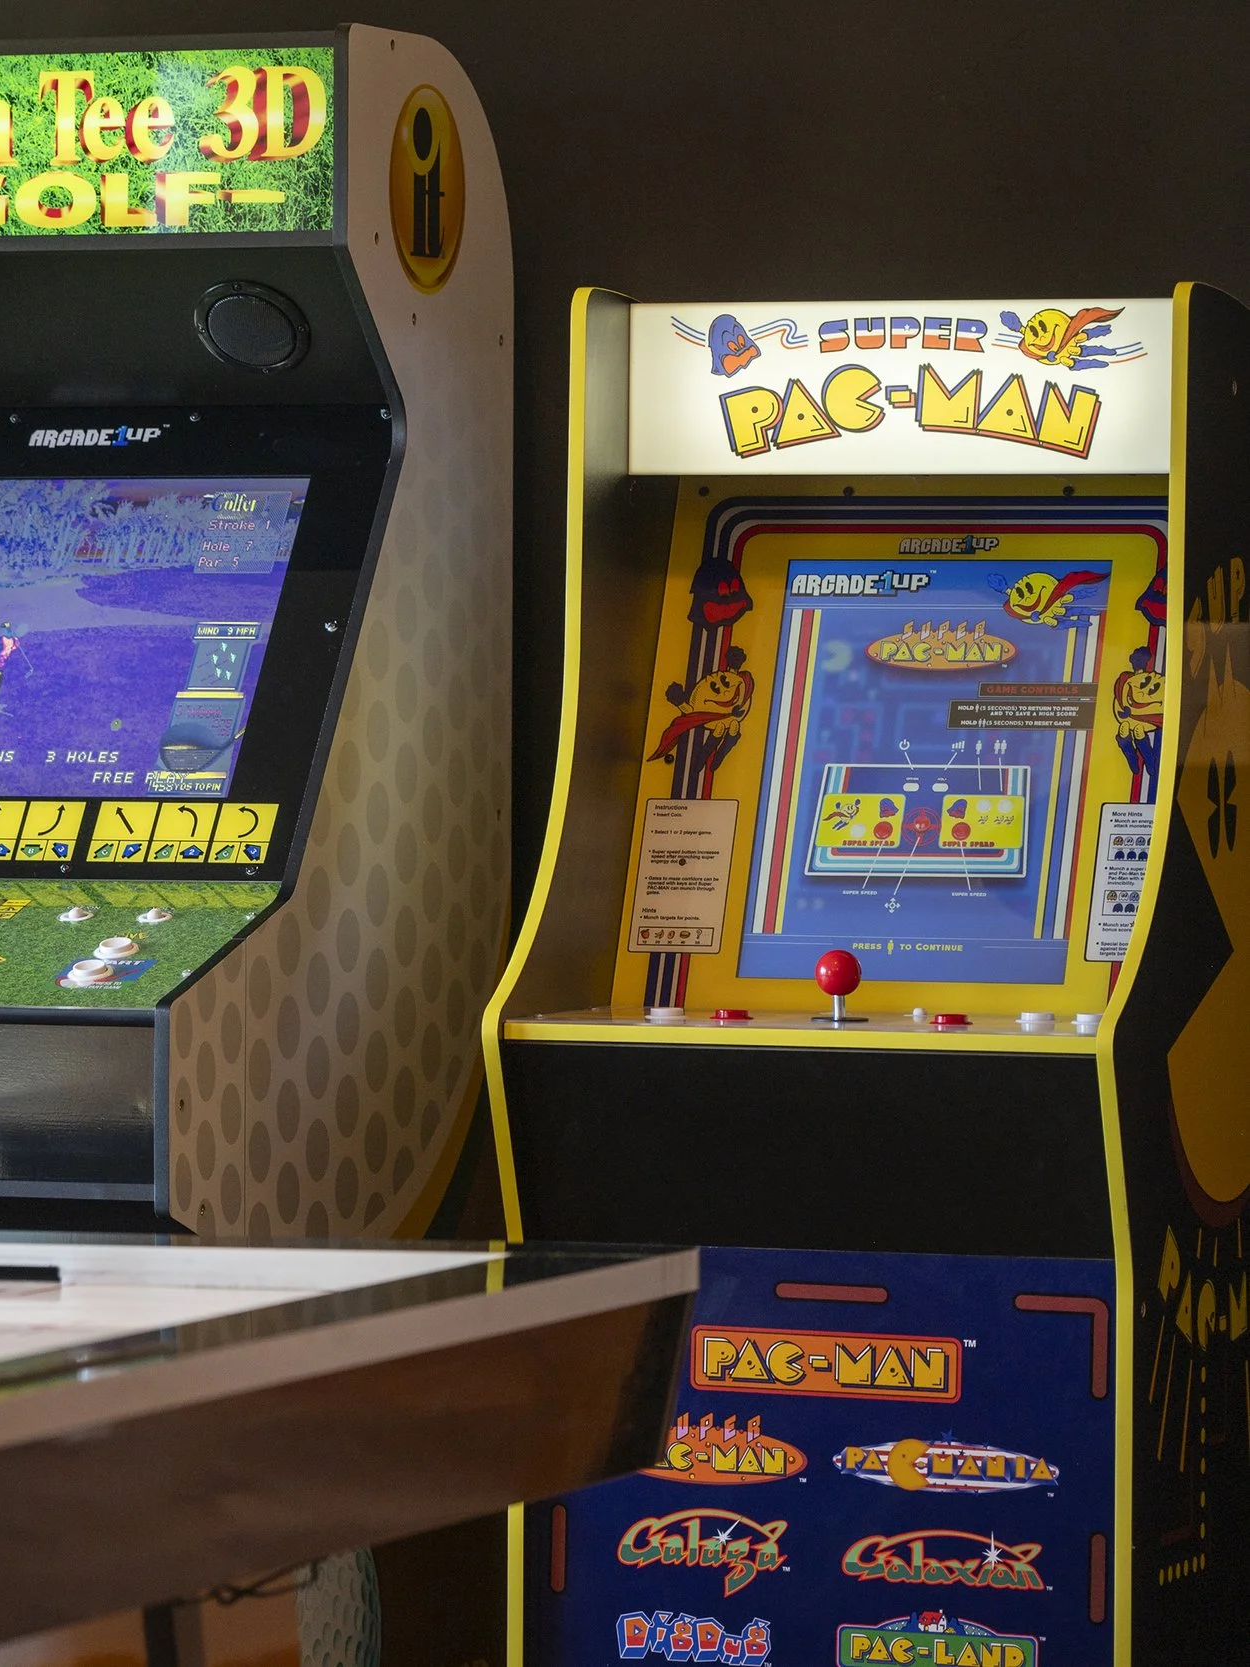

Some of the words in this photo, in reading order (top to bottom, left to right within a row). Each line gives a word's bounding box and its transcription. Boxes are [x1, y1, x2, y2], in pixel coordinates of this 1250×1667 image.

[38, 69, 177, 166] Tee
[199, 63, 327, 163] 3D
[818, 315, 986, 354] SUPER
[718, 363, 1102, 460] PAC-MAN
[28, 425, 161, 448] ARCADE1UP
[208, 520, 255, 530] Stroke
[265, 520, 271, 530] 1
[202, 541, 230, 551] Hole
[245, 541, 253, 551] 7
[198, 557, 222, 567] Par
[232, 556, 239, 567] 5
[197, 627, 219, 635] WIND
[902, 620, 986, 640] SUPER
[879, 640, 1003, 662] PAC-MAN
[986, 686, 1017, 694] GAME
[1021, 686, 1079, 694] CONTROLS
[45, 751, 56, 762] 3
[66, 751, 119, 762] HOLES
[92, 772, 135, 784] FREE
[900, 943, 911, 951] TO
[703, 1337, 949, 1392] PAC-MAN
[676, 1412, 761, 1443] UPER
[654, 1441, 787, 1476] C-MAN
[617, 1508, 789, 1598] Galaga
[842, 1530, 1045, 1591] Galaxian
[850, 1633, 1027, 1667] PAC-LAND
